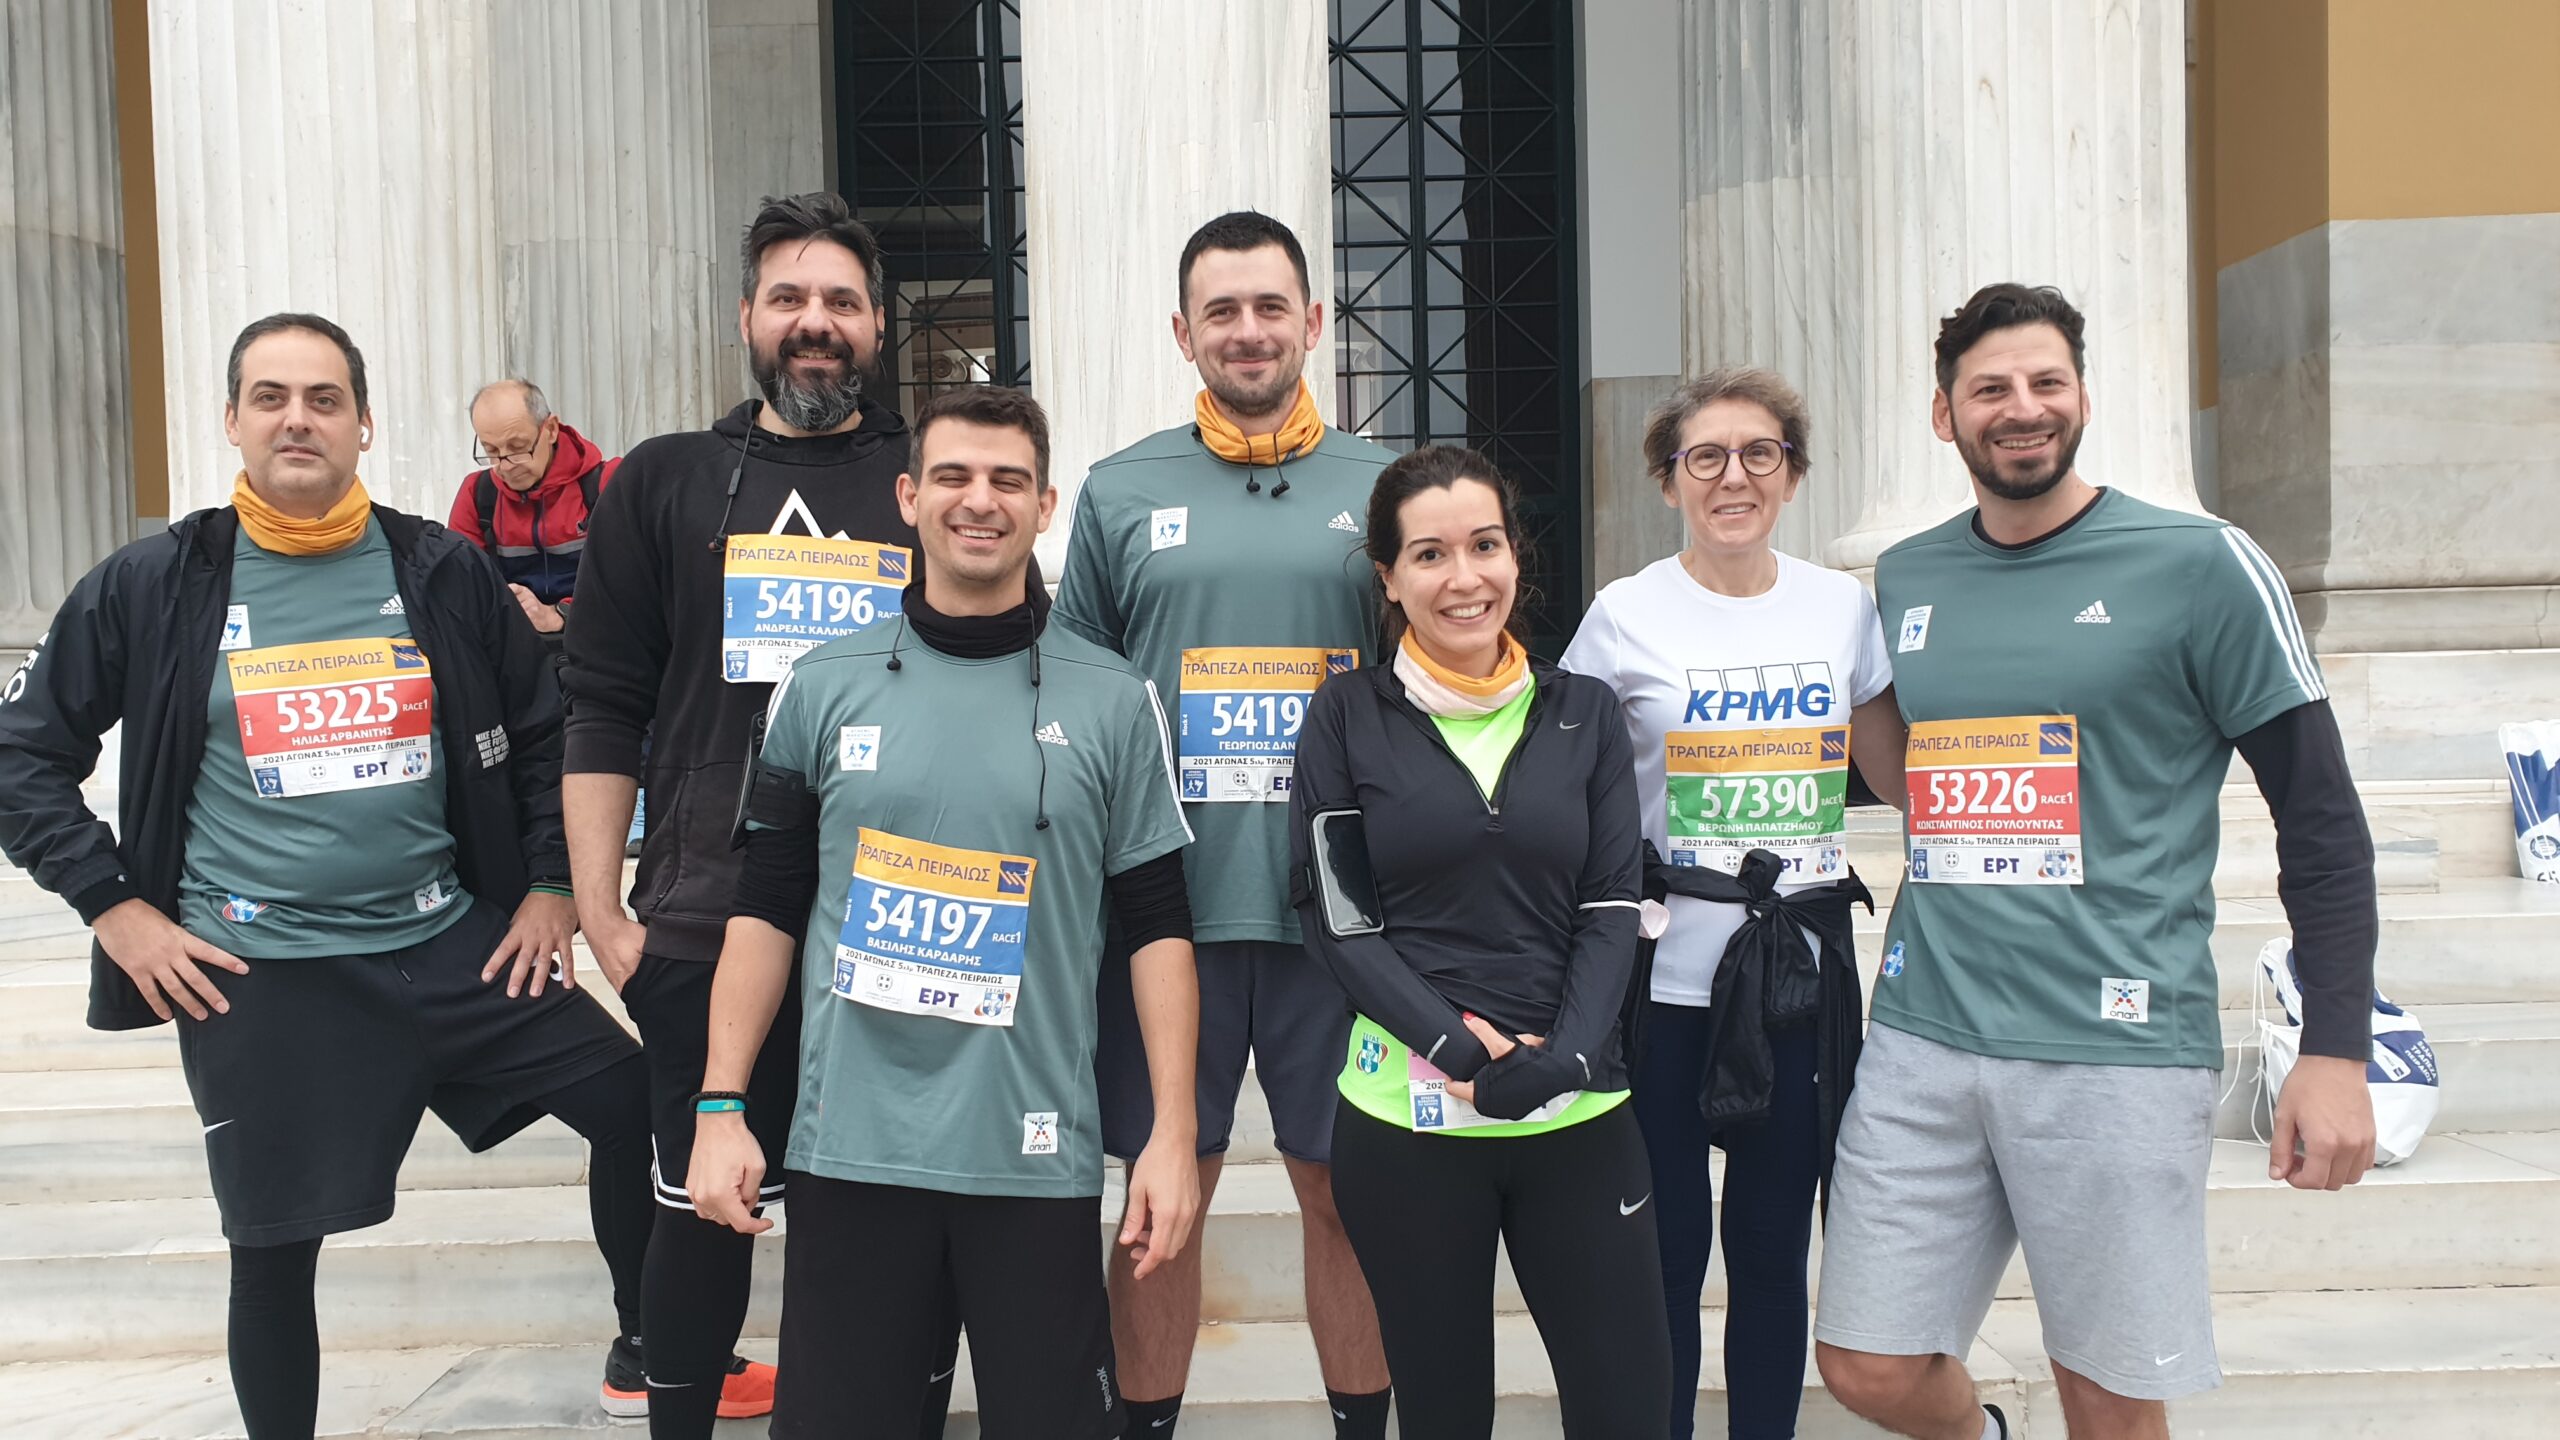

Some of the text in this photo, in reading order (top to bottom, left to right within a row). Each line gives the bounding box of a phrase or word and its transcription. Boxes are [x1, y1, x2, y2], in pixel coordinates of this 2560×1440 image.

[1328, 521, 1359, 533] adidas
[730, 548, 869, 567] ΤΡΑΠΕΖΑ ΠΕΙΡΑΙΩΣ
[756, 580, 874, 624] 54196
[2074, 614, 2112, 624] adidas
[754, 624, 860, 636] ΑΝΔΡΕΑΣ ΚΑΛΑΝΤ
[757, 640, 792, 648] ΑΓΩΝΑΣ
[235, 651, 384, 678] ΤΡΑΠΕΖΑ ΠΕΙΡΑΙΩΣ
[1184, 662, 1320, 676] ΤΡΑΠΕΖΑ ΠΕΙΡΑΙΩΣ
[277, 683, 398, 733] 53225
[1683, 682, 1831, 724] KPMG
[1212, 696, 1312, 736] 5419
[292, 726, 394, 746] ΗΛΙΑΣ ΑΡΒΑΝΙΤΗΣ
[1965, 733, 2030, 749] ΠΕΙΡΑΙΩΣ
[263, 755, 284, 764] 2021
[286, 750, 323, 762] ΑΓΩΝΑΣ
[342, 744, 383, 756] ΤΡΑΠΕΖΑ
[385, 739, 416, 750] ΠΕΙΡΑΙΩΣ
[1219, 741, 1270, 750] ΓΕΩΡΓΙΟΣ
[1668, 742, 1812, 759] ΤΡΑΠΕΖΑ ΠΕΙΡΑΙΩΣ
[353, 761, 388, 779] ΕΡΤ
[1194, 758, 1212, 766] 2021
[1214, 758, 1248, 766] ΑΓΩΝΑΣ
[1700, 776, 1819, 819] 57390
[1929, 770, 2036, 814] 53226
[1698, 821, 1824, 833] ΒΕΡΩΝΗ ΠΑΠΑΤΖΗΜΟΥ
[1916, 819, 2064, 830] ΚΩΝΣΤΑΝΤΙΝΟΣ ΓΙΟΥΛΟΥΝΤΑΣ
[1682, 839, 1701, 847] 2021
[1704, 840, 1740, 848] ΑΓΩΝΑΣ
[1757, 839, 1798, 847] ΤΡΑΠΕΖΑ
[1800, 836, 1832, 845] ΠΕΙΡΑΙΩΣ
[1932, 837, 1960, 845] ΑΓΩΝΑΣ
[1976, 837, 2014, 846] ΤΡΑΠΕΖΑ
[2017, 837, 2060, 846] ΠΕΙΡΑΙΩΣ
[860, 842, 990, 882] ΤΡΑΠΕΖΑ ΠΕΙΡΑΙΩΣ
[1984, 857, 2019, 874] ΕΡΤ
[865, 887, 992, 950] 54197
[867, 936, 982, 966] ΒΑΣΙΛΗΣ ΚΑΡΔΑΡΗΣ
[846, 948, 862, 962] 2021
[863, 954, 896, 969] ΑΓΩΝΑΣ
[916, 965, 958, 980] ΤΡΑΠΕΖΑ
[960, 972, 1004, 985] ΠΕΙΡΑΙΩΣ
[919, 987, 960, 1008] ΕΡΤ
